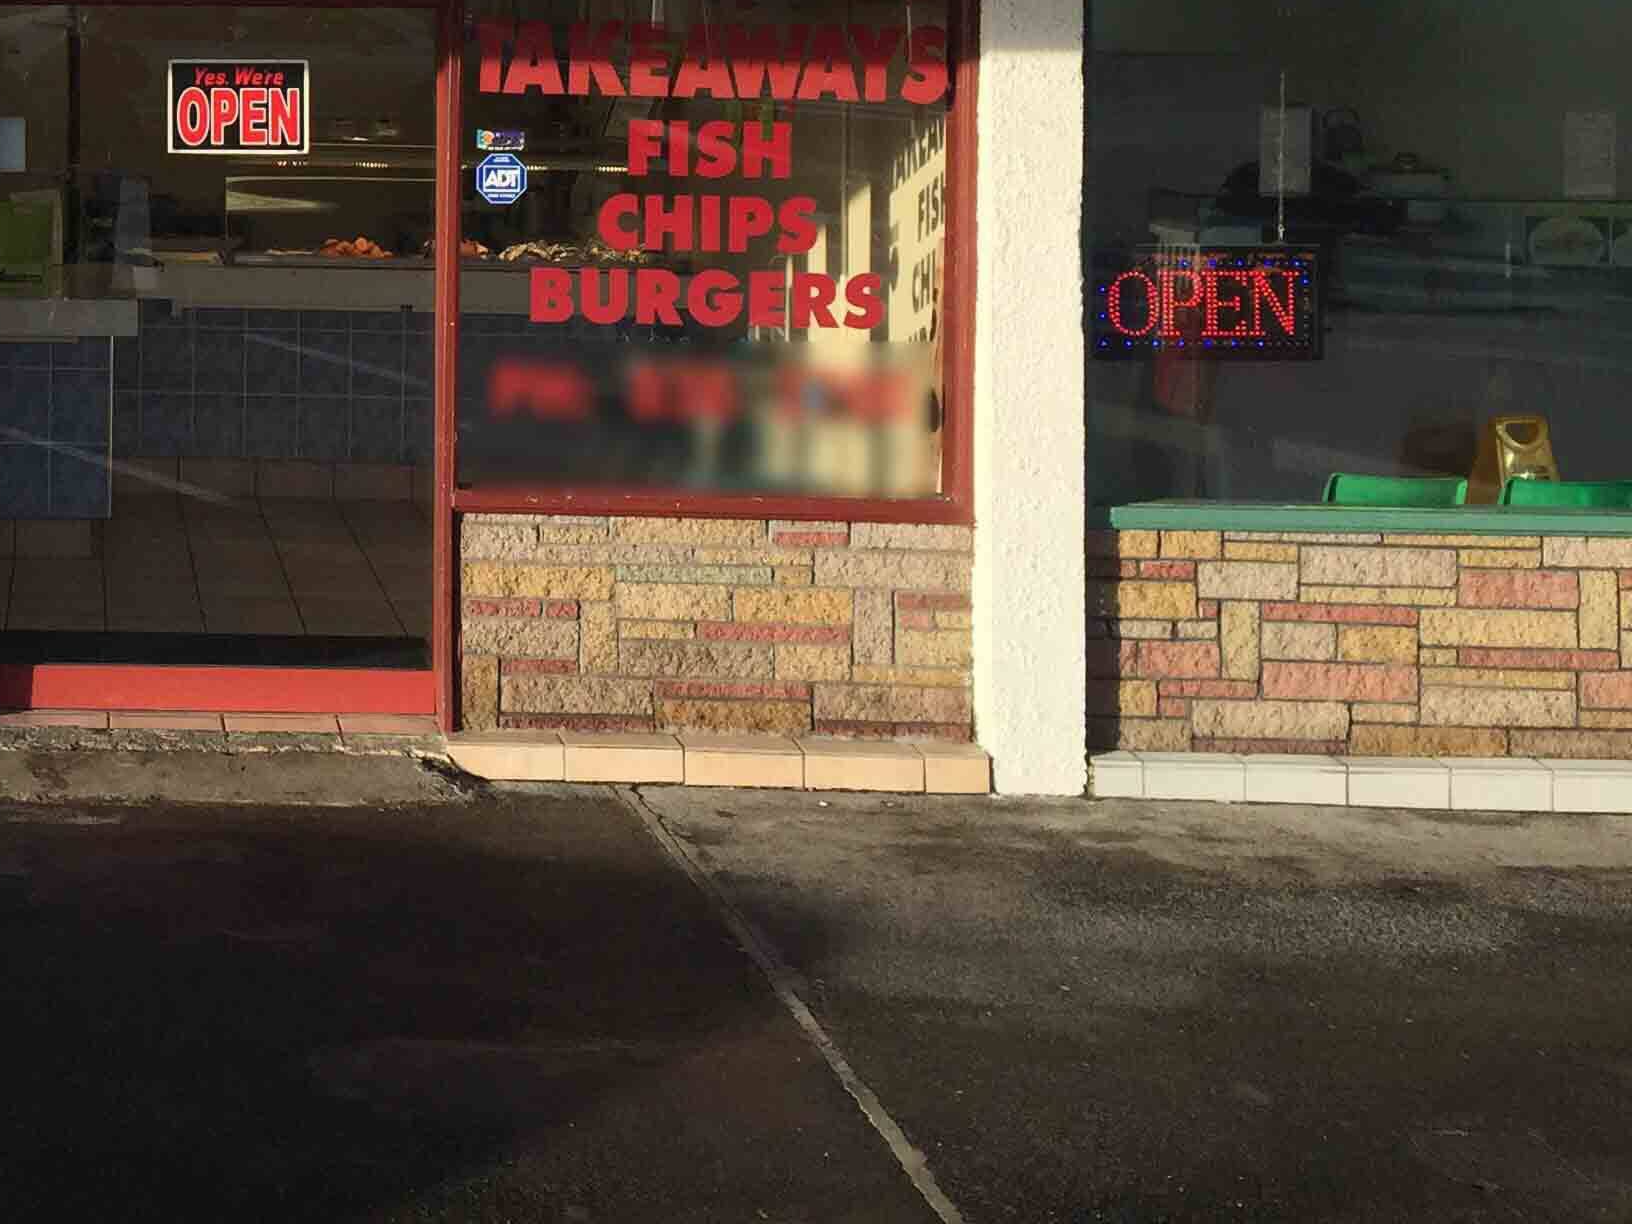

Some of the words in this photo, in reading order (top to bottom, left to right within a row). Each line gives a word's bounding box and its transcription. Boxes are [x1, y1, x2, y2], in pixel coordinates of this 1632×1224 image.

[475, 19, 948, 104] TAKEAWAYS
[177, 86, 301, 146] OPEN
[485, 169, 520, 187] ADT
[626, 120, 793, 179] FISH
[597, 193, 819, 255] CHIPS
[528, 266, 887, 330] BURGERS
[1106, 271, 1300, 336] OPEN
